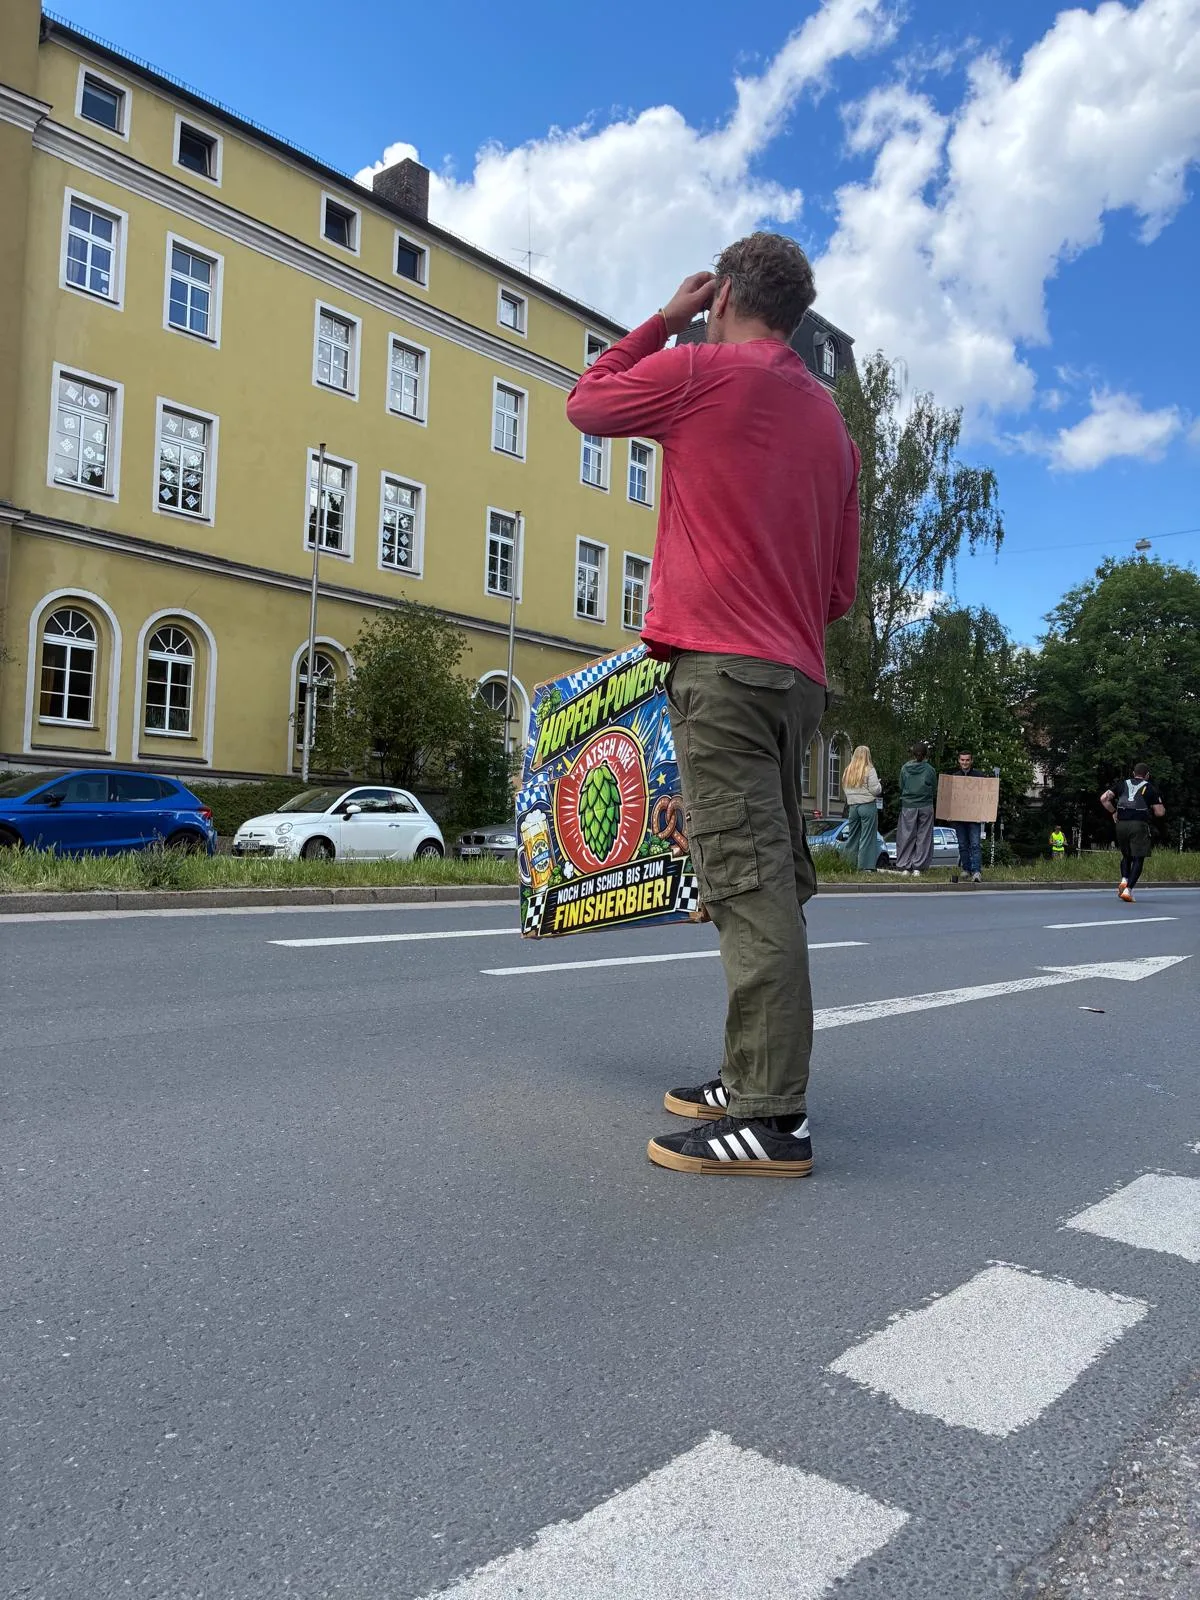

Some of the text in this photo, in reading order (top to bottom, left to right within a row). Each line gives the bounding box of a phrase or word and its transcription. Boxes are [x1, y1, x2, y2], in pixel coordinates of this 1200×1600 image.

[553, 875, 673, 931] FINISHERBIER!
[557, 860, 664, 904] NOCH EIN SCHUB BIS ZUM
